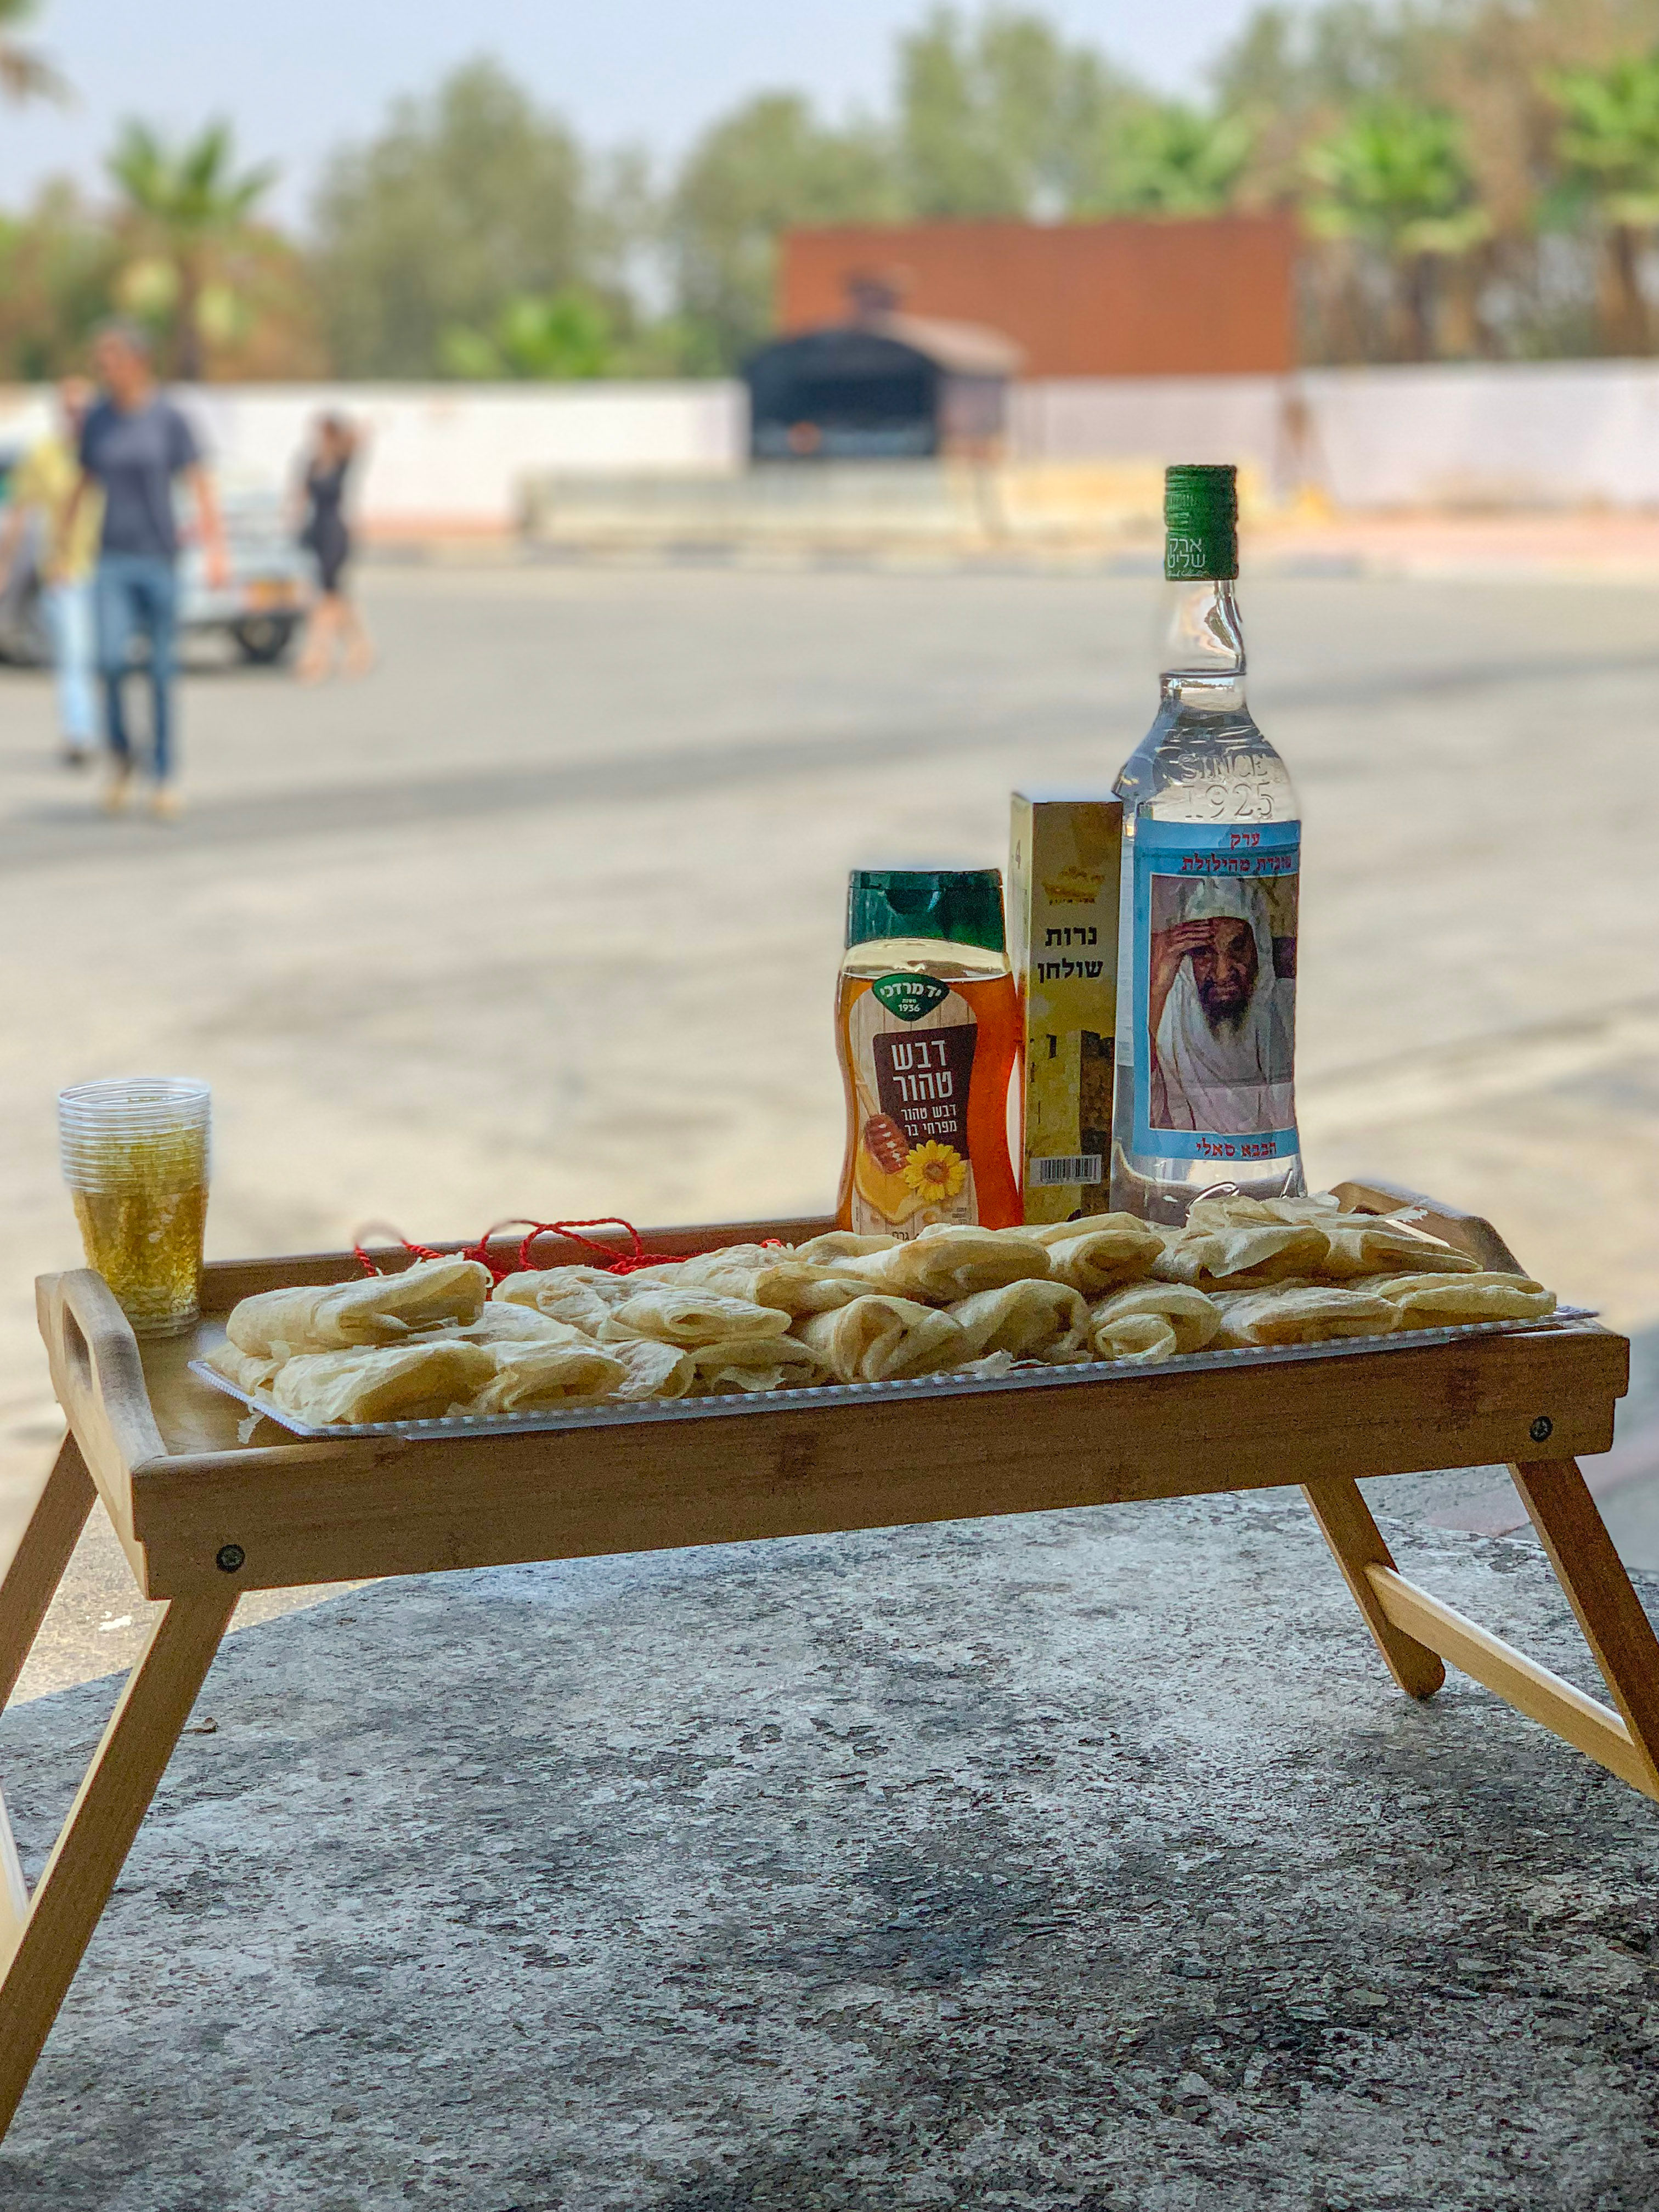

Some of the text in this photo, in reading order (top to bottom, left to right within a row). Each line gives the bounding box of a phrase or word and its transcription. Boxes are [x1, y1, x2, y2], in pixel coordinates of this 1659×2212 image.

[1169, 538, 1201, 555] ארק
[1167, 550, 1205, 568] שליט
[1179, 753, 1268, 780] SINCE
[1182, 782, 1275, 820] 1925
[1231, 833, 1260, 850] ערק
[1182, 853, 1250, 872] מהילולת
[1045, 926, 1097, 946] נרות
[1037, 957, 1103, 984] שולחן
[879, 983, 942, 997] יד מרדכי
[898, 1004, 921, 1012] 1936
[891, 1040, 947, 1070] דבש
[893, 1071, 953, 1102] טהור
[901, 1104, 956, 1121] דבש טהור
[905, 1120, 957, 1136] מפרחי בר
[1195, 1137, 1277, 1157] הבבא סאלי
